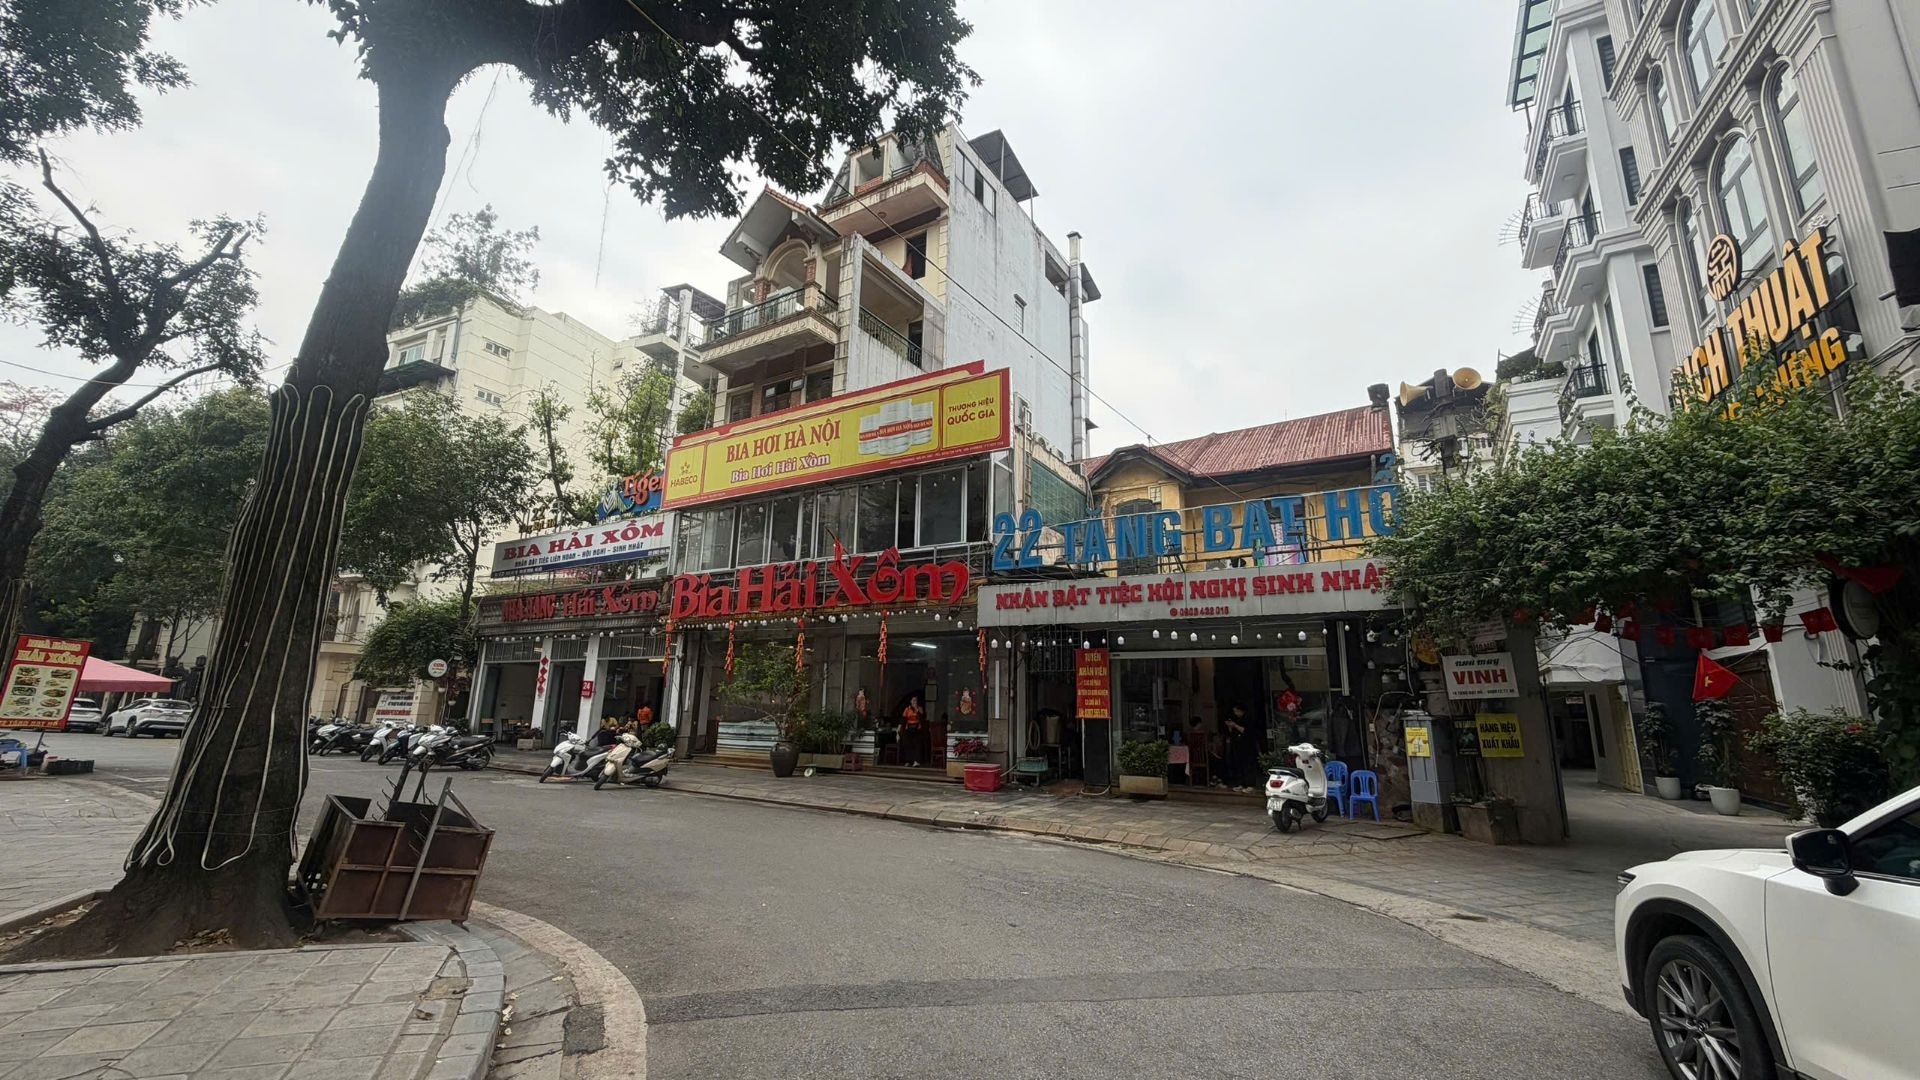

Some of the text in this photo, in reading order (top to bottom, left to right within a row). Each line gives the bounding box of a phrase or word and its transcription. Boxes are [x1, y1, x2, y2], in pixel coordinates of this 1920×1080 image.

[1726, 229, 1829, 371] THUẬT
[947, 409, 976, 426] QUỐC
[978, 408, 996, 421] GIA
[726, 442, 749, 463] BIA
[752, 434, 781, 457] HƠI
[784, 424, 807, 450] HÀ
[810, 418, 841, 447] NỘI
[670, 475, 698, 489] HABECO
[731, 468, 750, 483] Bia
[751, 462, 774, 480] Hơi
[504, 520, 664, 560] BIA HẢI XỒM
[992, 507, 1043, 571] 22
[1062, 507, 1182, 565] TĂNG
[1202, 496, 1305, 560] BẠT
[670, 572, 732, 620] Bia
[996, 586, 1049, 612] NHẬN
[1053, 584, 1091, 610] ĐẶT
[1096, 580, 1142, 608] TIỆC
[1147, 577, 1185, 605] HỘI
[1190, 576, 1247, 602] NGHỊ
[1252, 571, 1314, 597] SINH
[1452, 669, 1508, 685] VINH
